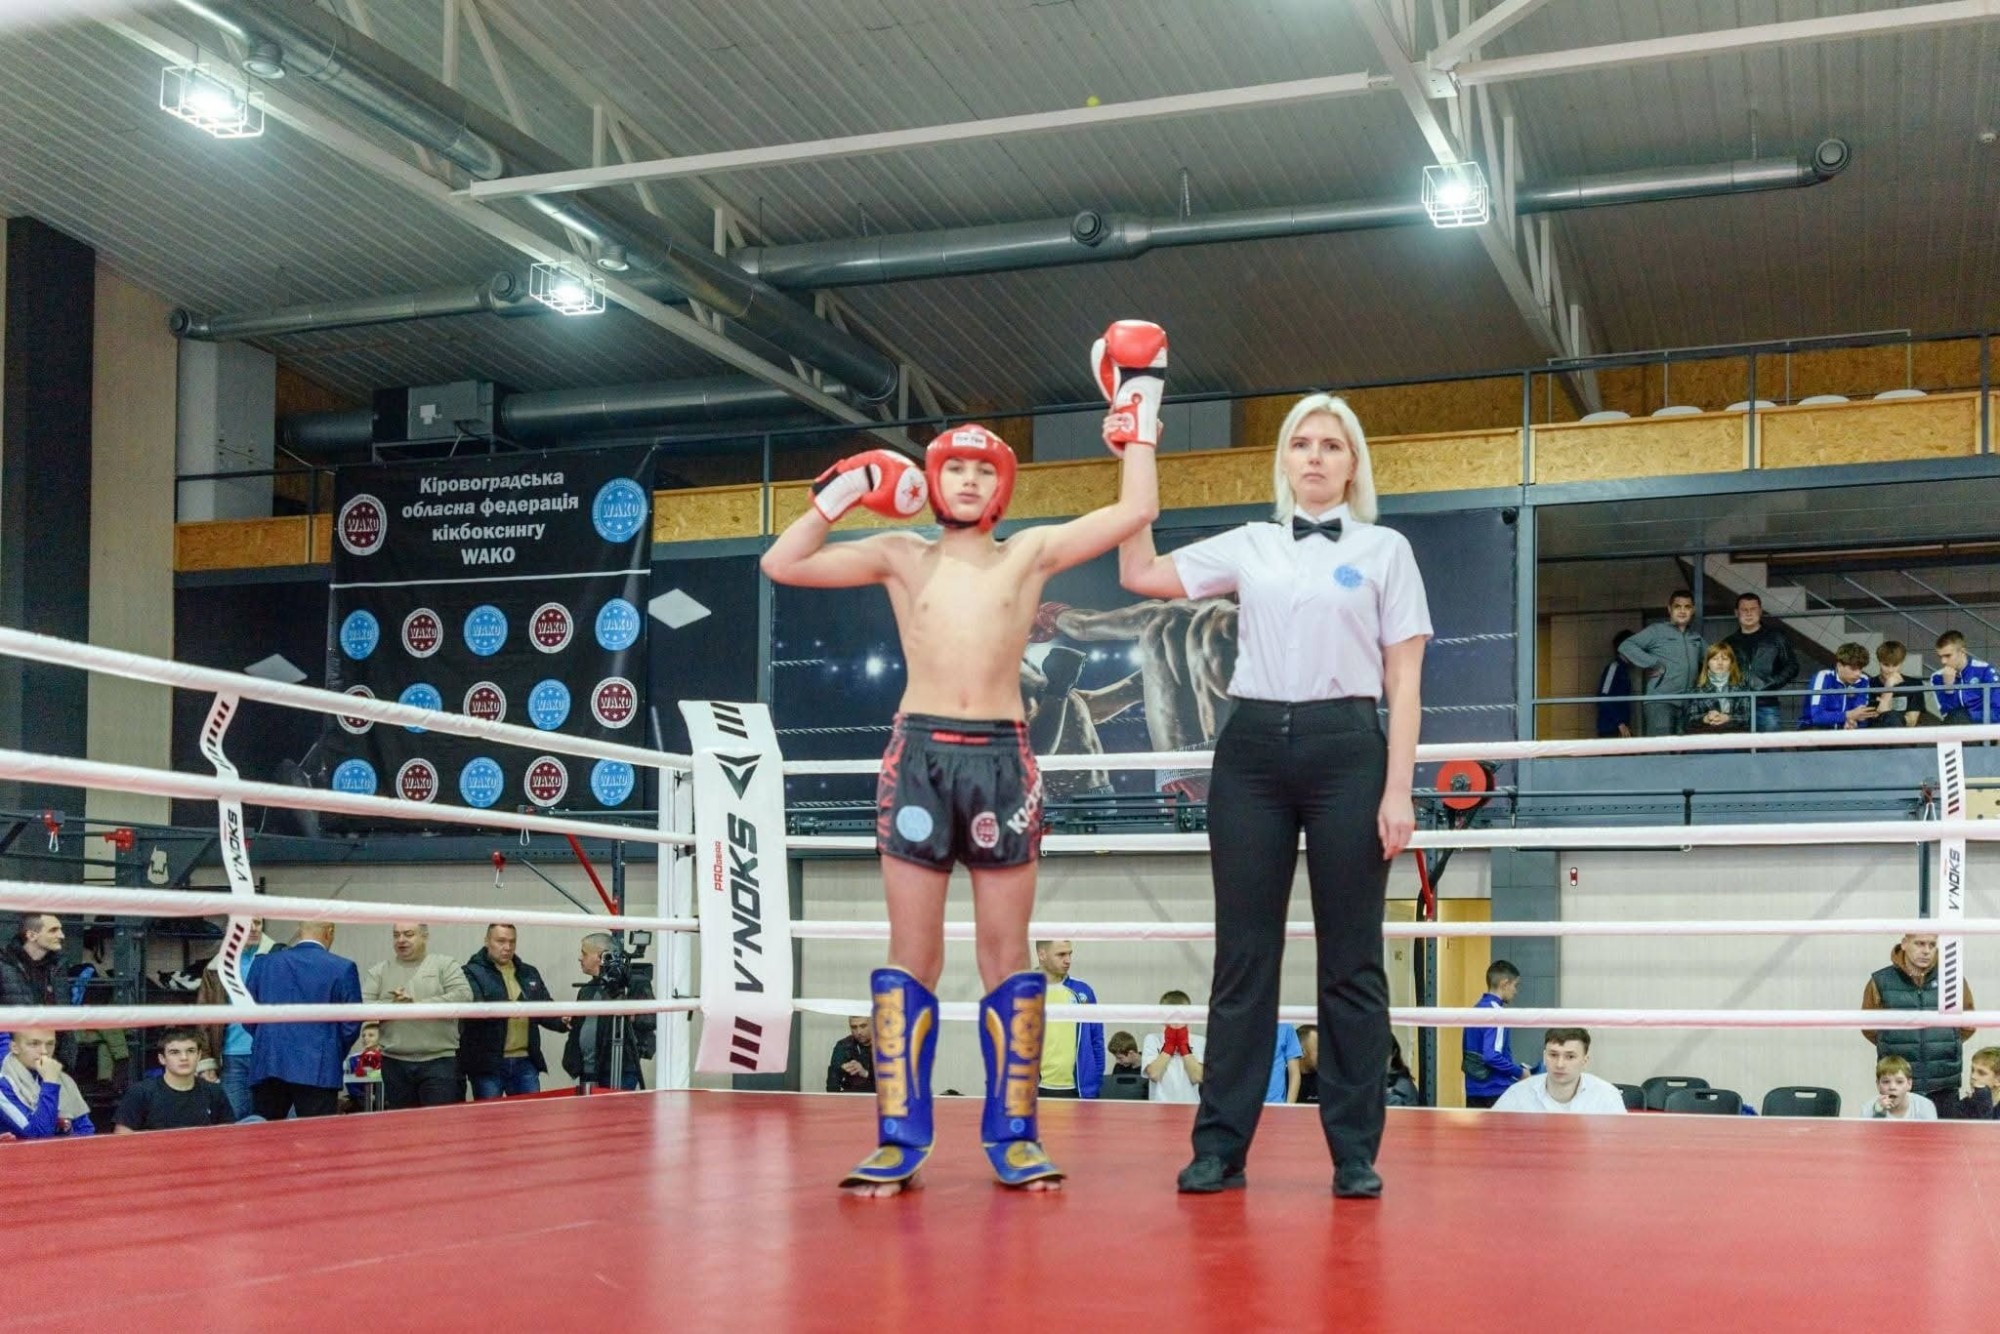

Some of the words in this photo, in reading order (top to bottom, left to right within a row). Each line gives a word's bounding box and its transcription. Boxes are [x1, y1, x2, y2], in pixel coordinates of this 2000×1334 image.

[420, 472, 564, 496] Кіровоградська
[402, 501, 475, 518] обласна
[480, 493, 579, 517] федерація
[603, 502, 640, 518] WAKO
[347, 517, 380, 532] WAKO
[432, 523, 546, 541] кікбоксингу
[461, 546, 516, 565] WAKO
[538, 621, 567, 634] WAKO
[603, 618, 633, 631] WAKO
[410, 627, 437, 639] WAKO
[472, 700, 500, 713] WAKO
[600, 697, 632, 709] WAKO
[404, 777, 432, 789] WAKO
[532, 775, 562, 787] WAKO
[1948, 848, 1961, 910] V'NOKS
[728, 812, 764, 993] V'NOKS
[874, 988, 906, 1058] TOP
[1010, 994, 1044, 1060] TOP
